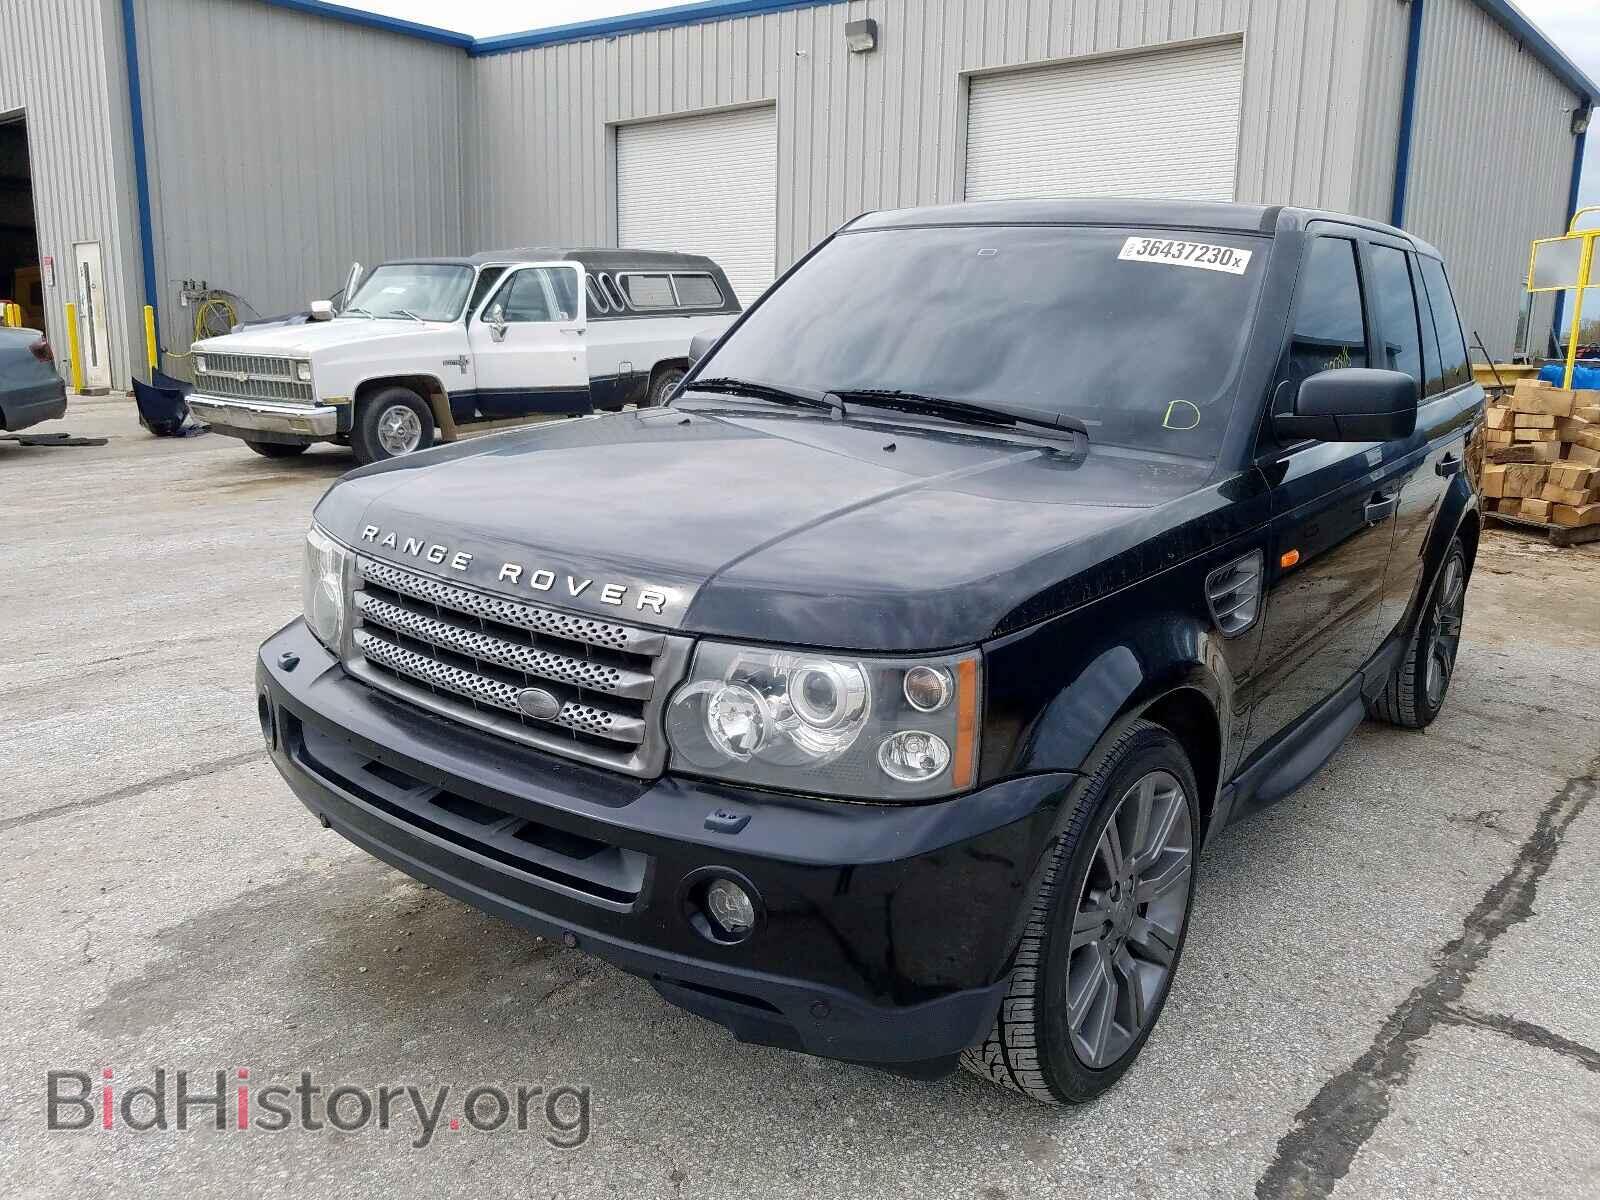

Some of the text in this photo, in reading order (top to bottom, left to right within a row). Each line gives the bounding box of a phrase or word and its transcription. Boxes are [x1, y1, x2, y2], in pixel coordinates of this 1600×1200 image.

[1162, 399, 1201, 431] D
[361, 524, 667, 615] RANGE ROVER
